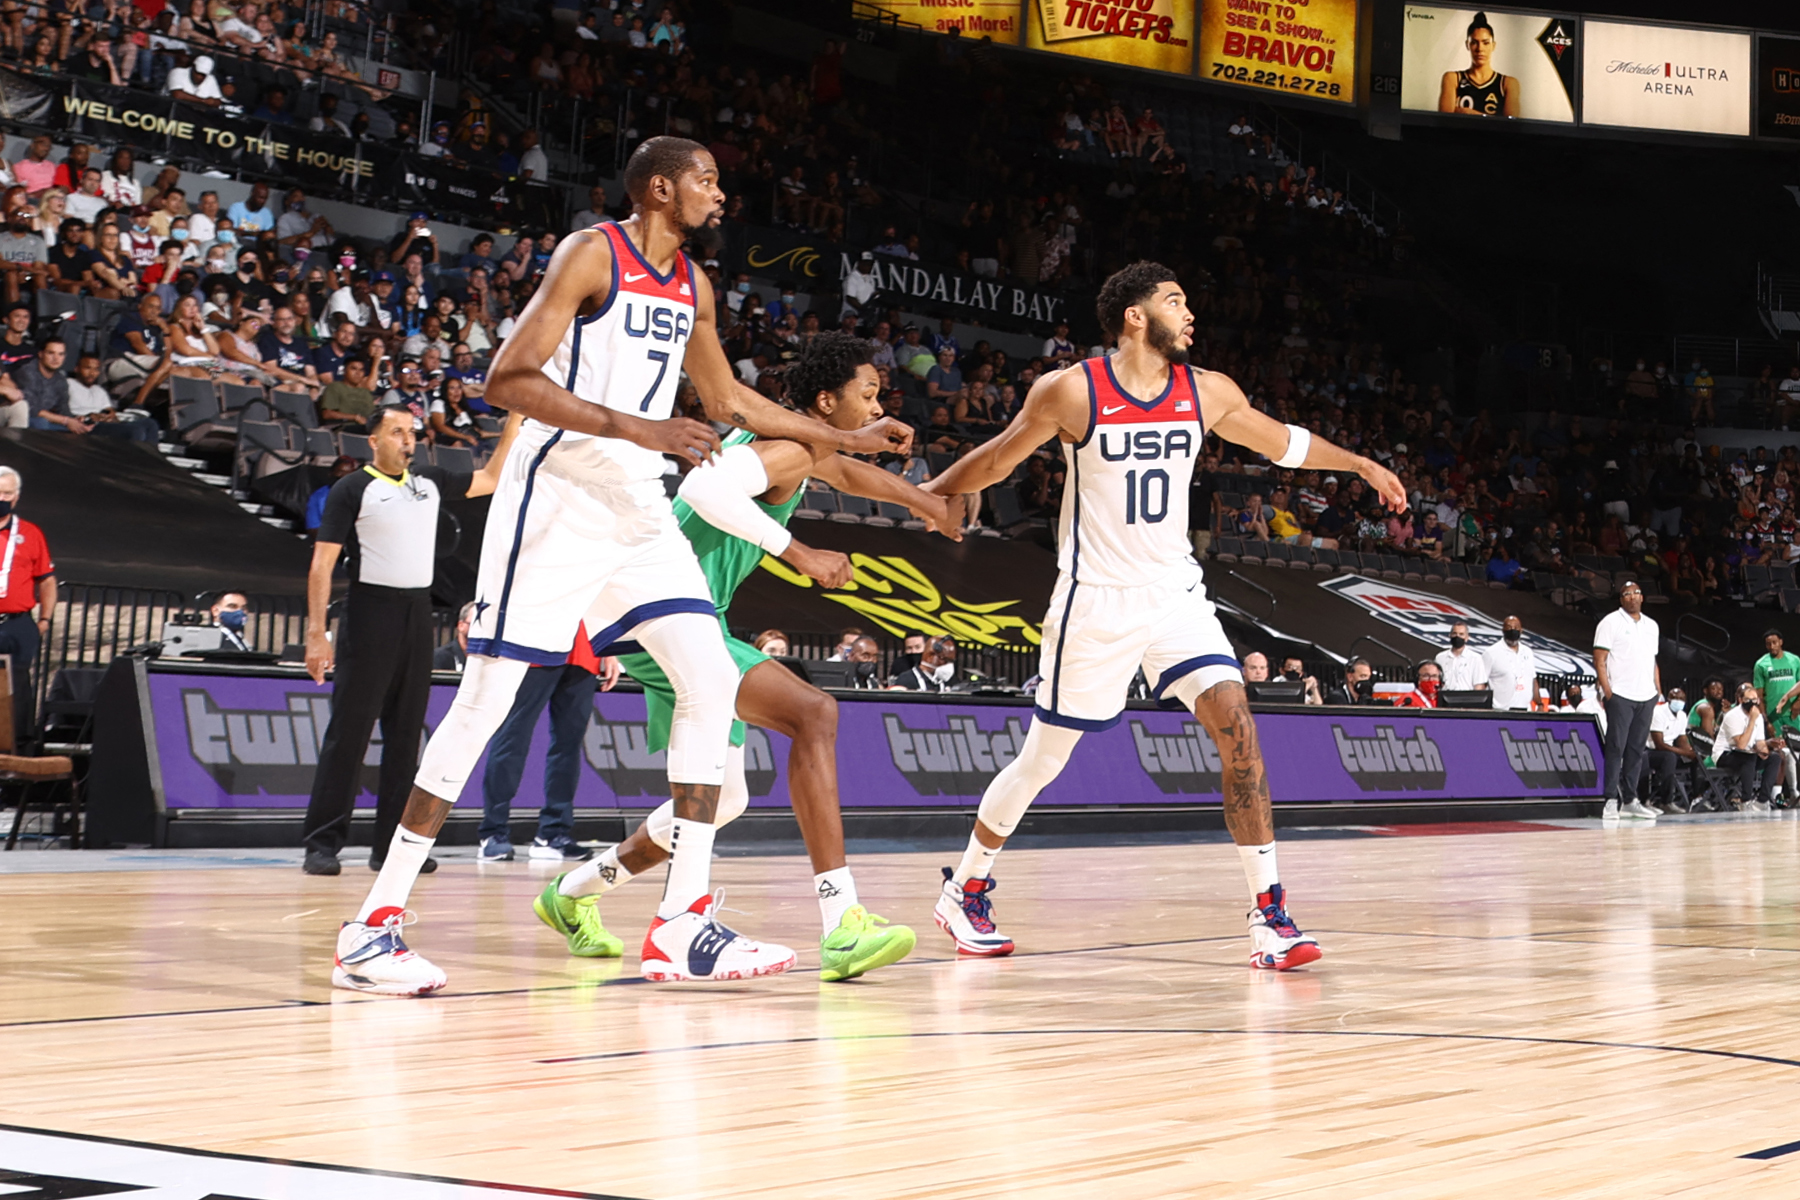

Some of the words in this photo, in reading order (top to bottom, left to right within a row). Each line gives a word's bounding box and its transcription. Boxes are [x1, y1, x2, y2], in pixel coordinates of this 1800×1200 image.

[936, 16, 964, 32] and
[968, 16, 1014, 32] More!
[1225, 12, 1257, 29] SEE
[1259, 18, 1270, 32] A
[1275, 5, 1295, 20] TO
[1222, 31, 1335, 73] BRAVO!
[1546, 37, 1572, 46] ACES
[1212, 62, 1341, 96] 702.221.2728
[1374, 76, 1399, 93] 216
[1605, 60, 1660, 76] Michelob
[1675, 66, 1729, 82] ULTRA
[1643, 82, 1694, 96] ARENA
[63, 96, 195, 141] WELCOME
[202, 127, 238, 149] TO
[244, 136, 290, 160] THE
[296, 147, 376, 178] HOUSE
[1011, 289, 1058, 323] BAY
[624, 302, 689, 348] USA
[639, 349, 670, 413] 7
[1100, 429, 1192, 462] USA
[1125, 468, 1170, 524] 10
[1331, 724, 1445, 773] twitch
[1499, 728, 1597, 773] twitch
